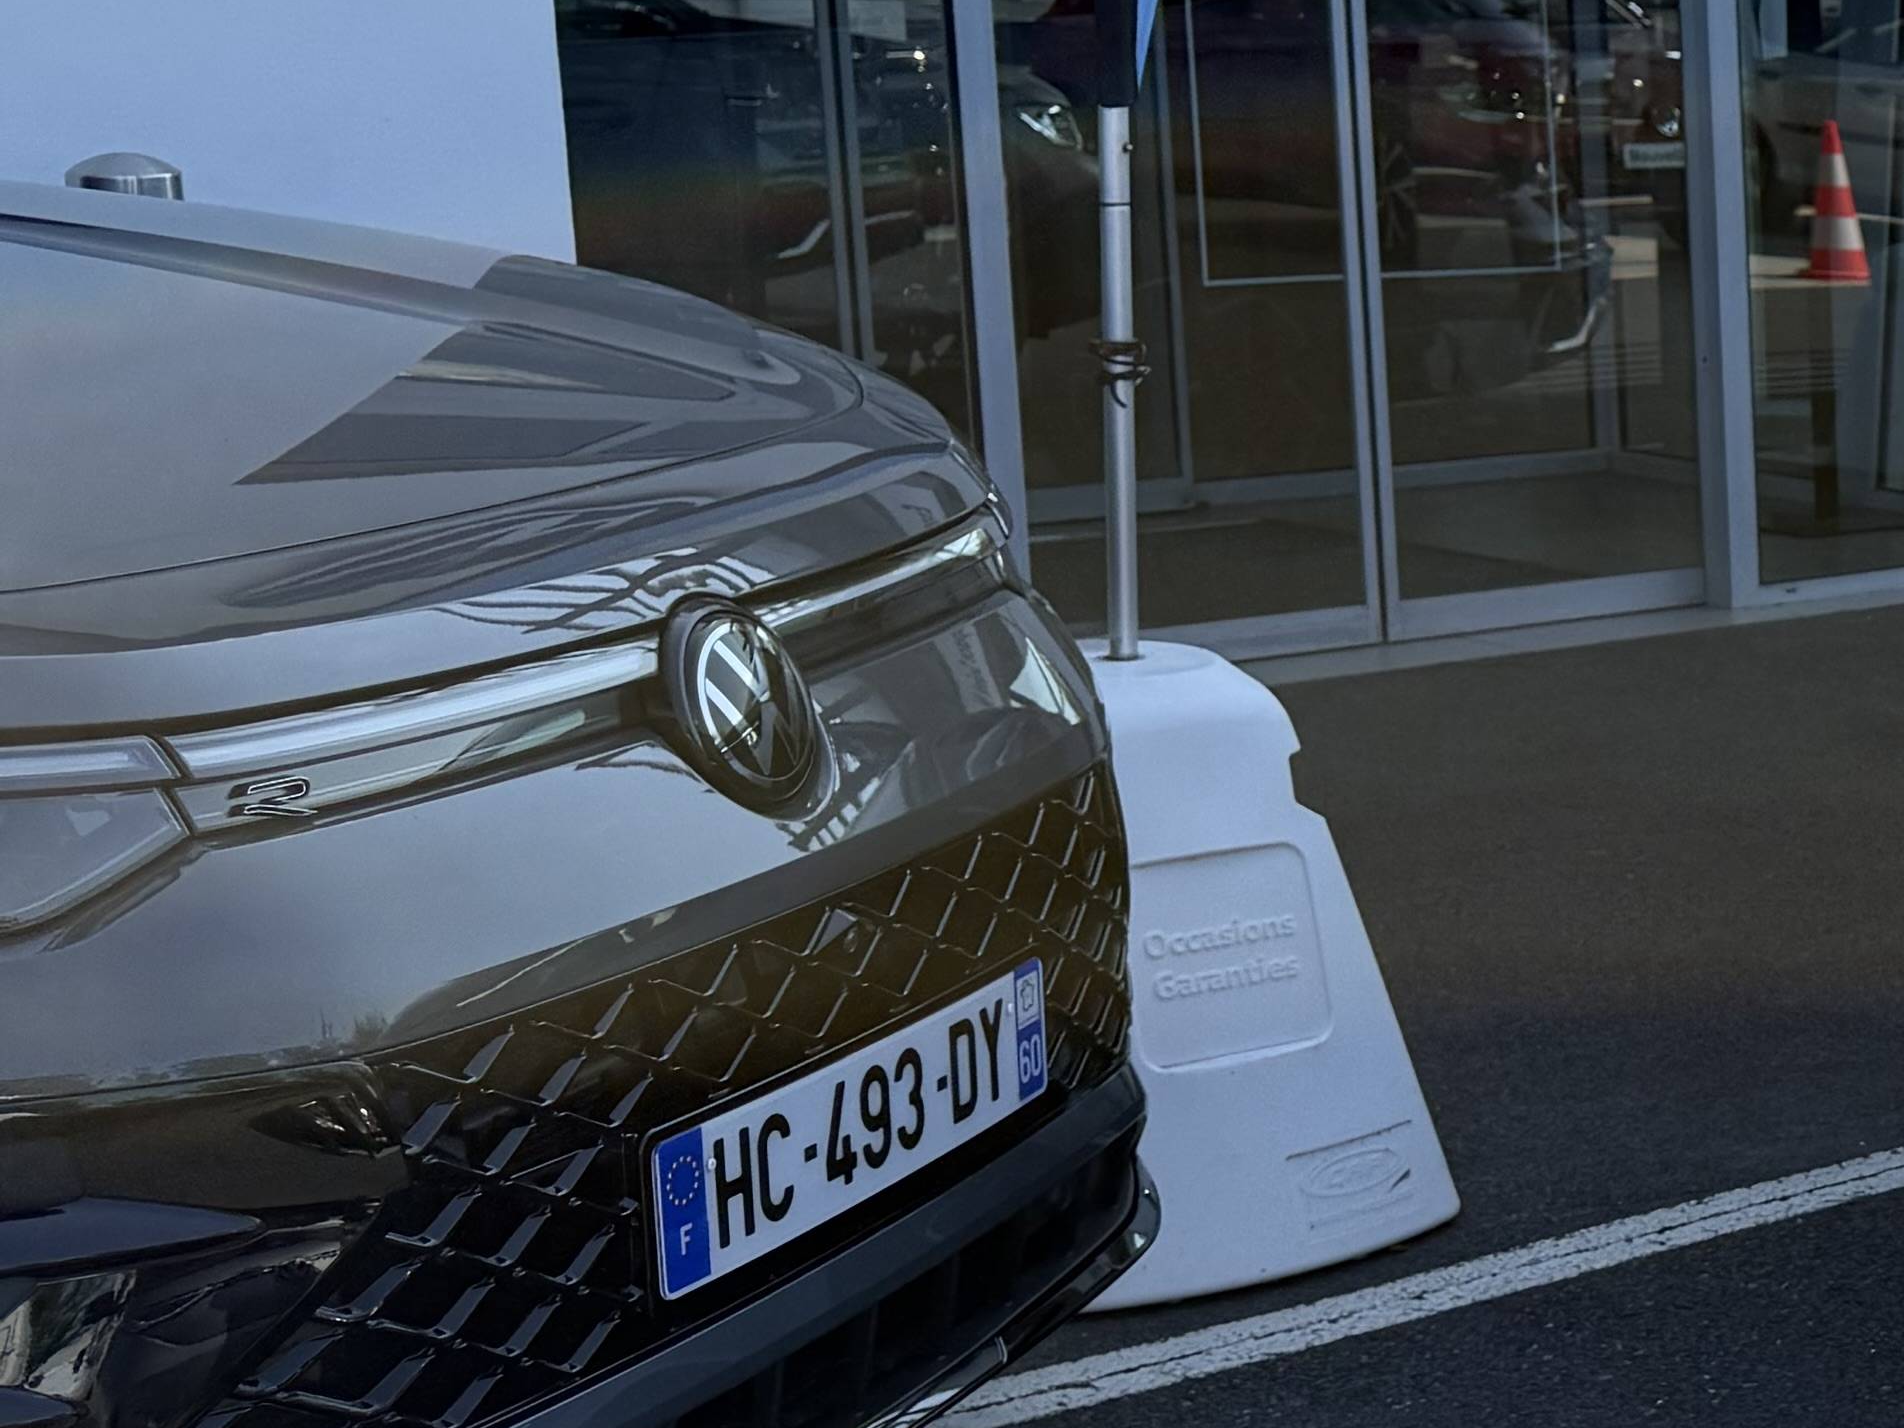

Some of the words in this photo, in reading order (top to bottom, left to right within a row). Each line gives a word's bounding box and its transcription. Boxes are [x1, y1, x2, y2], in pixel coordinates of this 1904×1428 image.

[1143, 913, 1297, 960] Occasions
[1153, 955, 1300, 1001] Garanties
[680, 1222, 694, 1256] F
[711, 998, 1005, 1250] HC-493-DY
[1017, 1032, 1043, 1082] 60
